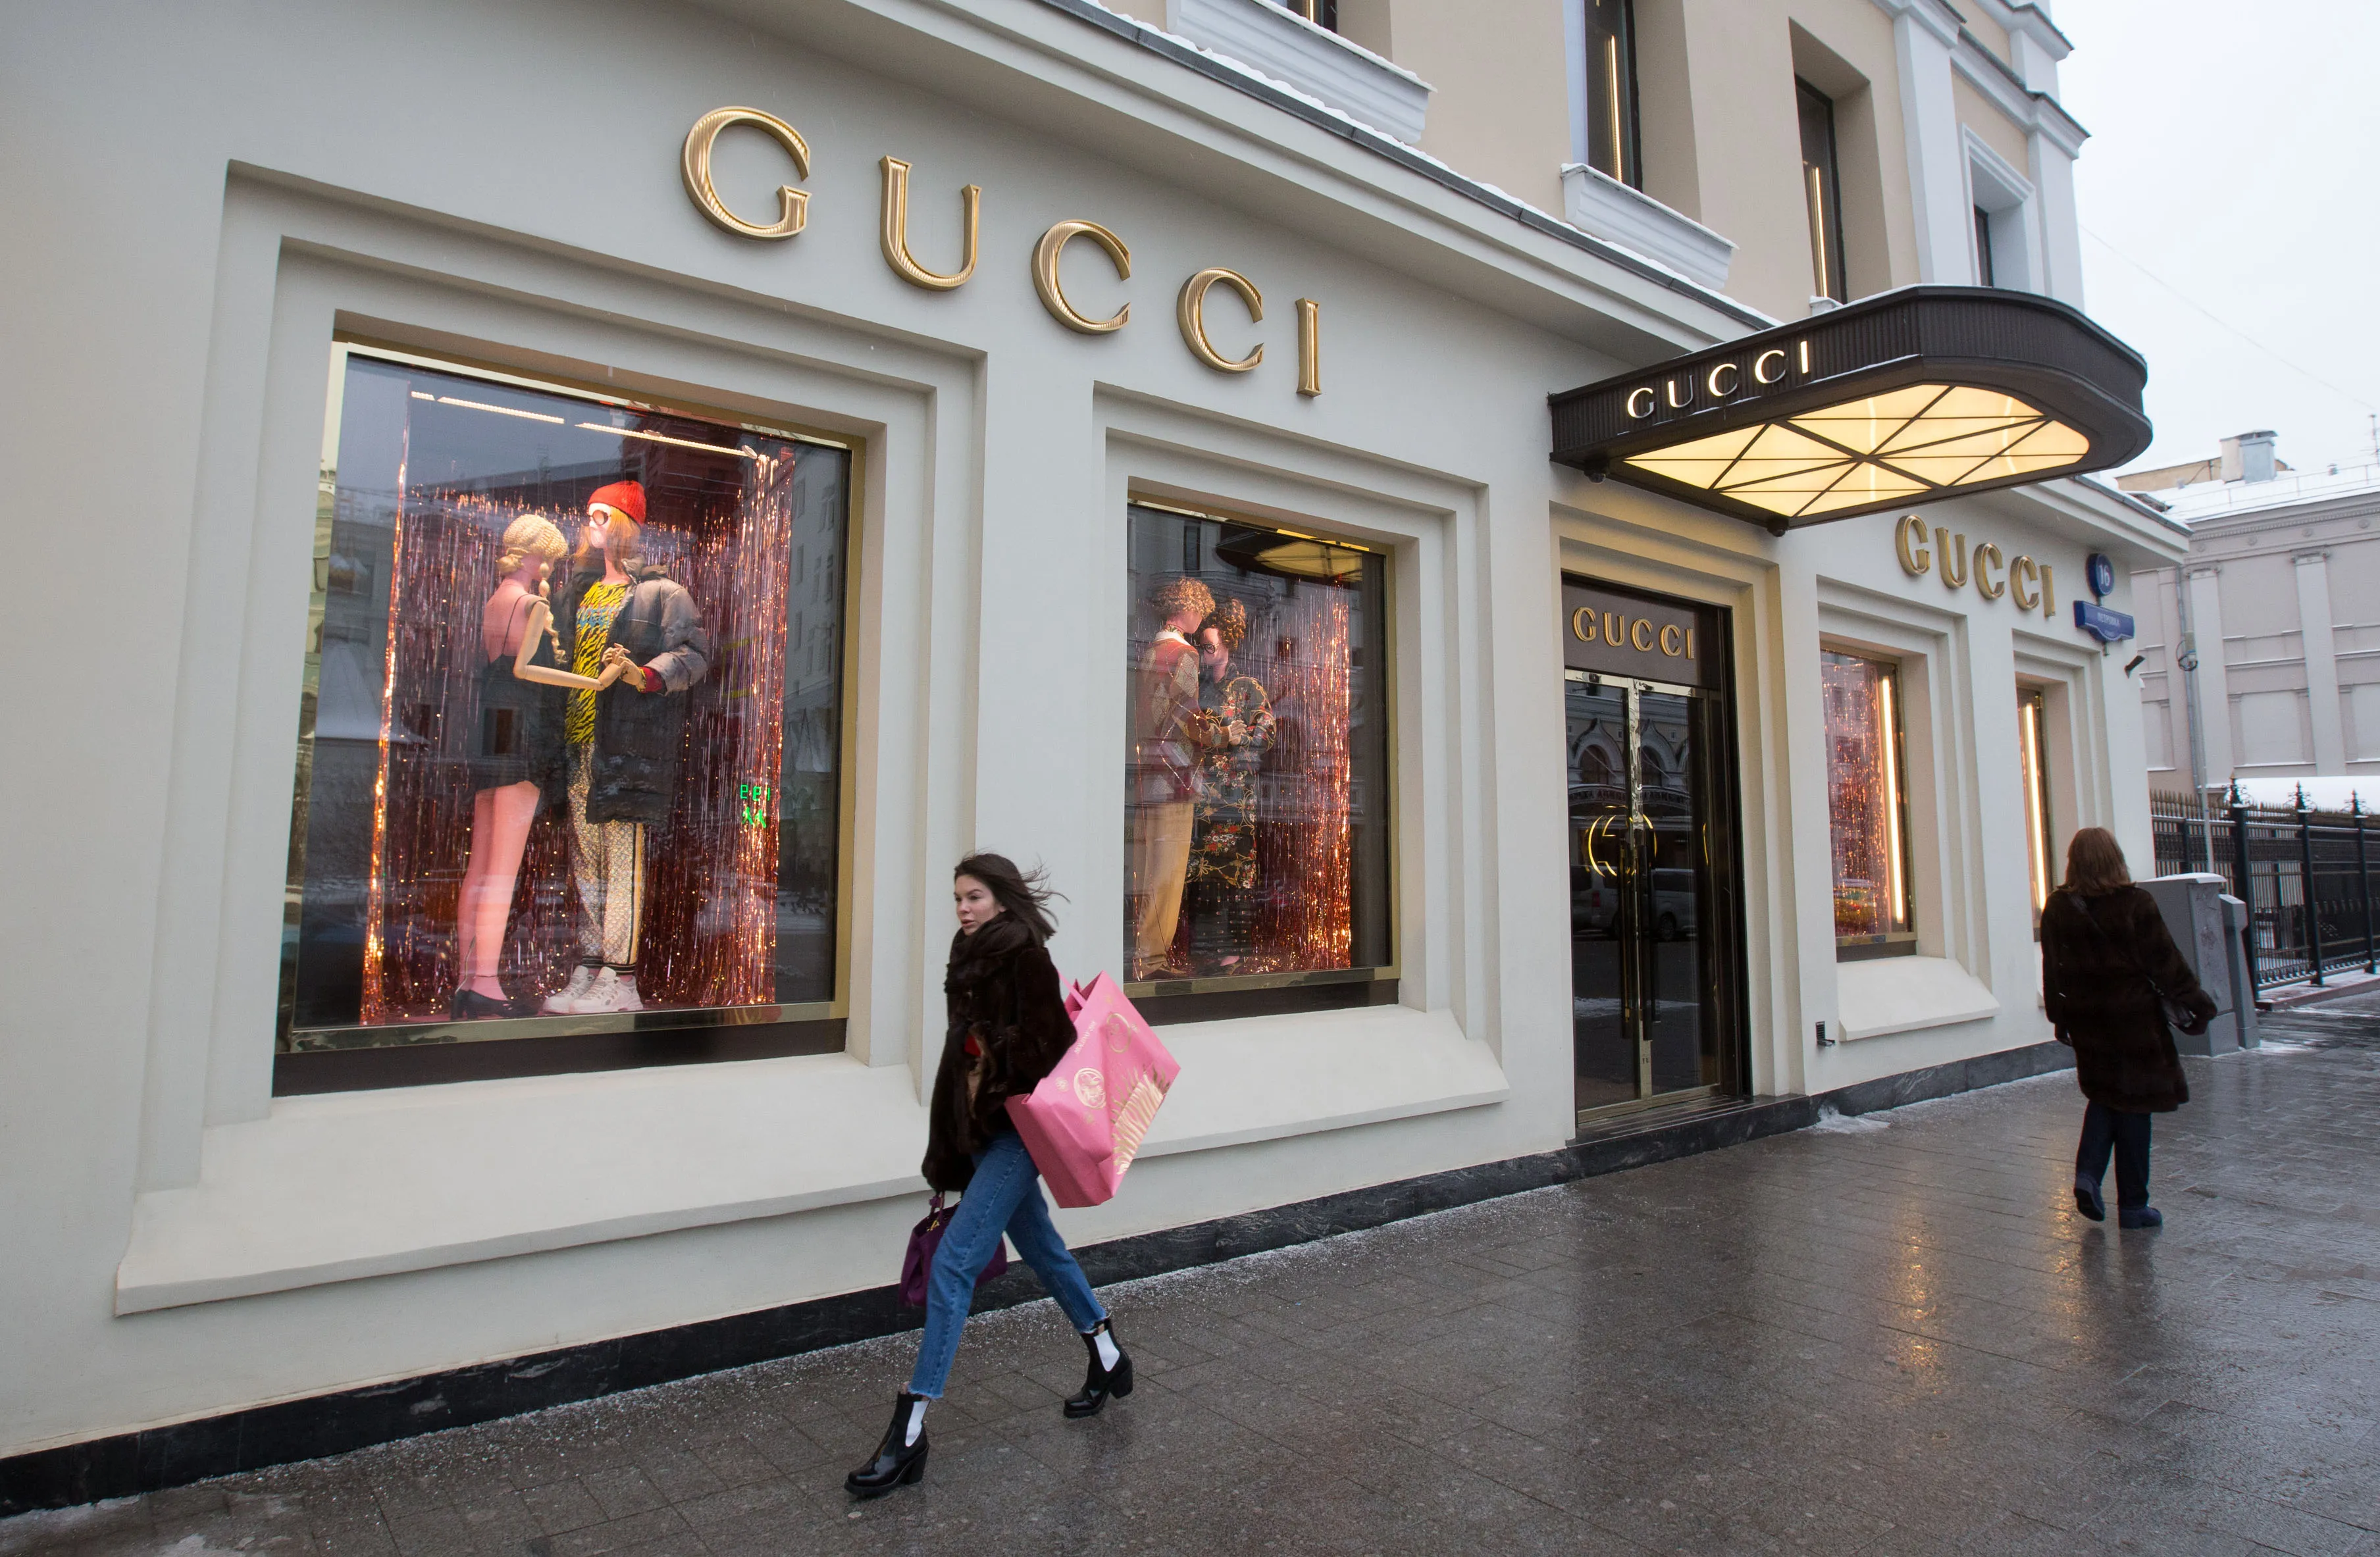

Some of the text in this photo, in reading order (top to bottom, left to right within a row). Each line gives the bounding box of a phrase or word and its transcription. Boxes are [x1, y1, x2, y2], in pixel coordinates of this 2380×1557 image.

[680, 105, 1322, 397] GUCCI
[1627, 340, 1809, 419] GUCCI
[1896, 514, 2056, 617] GUCCI
[2099, 565, 2111, 586] 16
[1572, 606, 1695, 660] GUCCI
